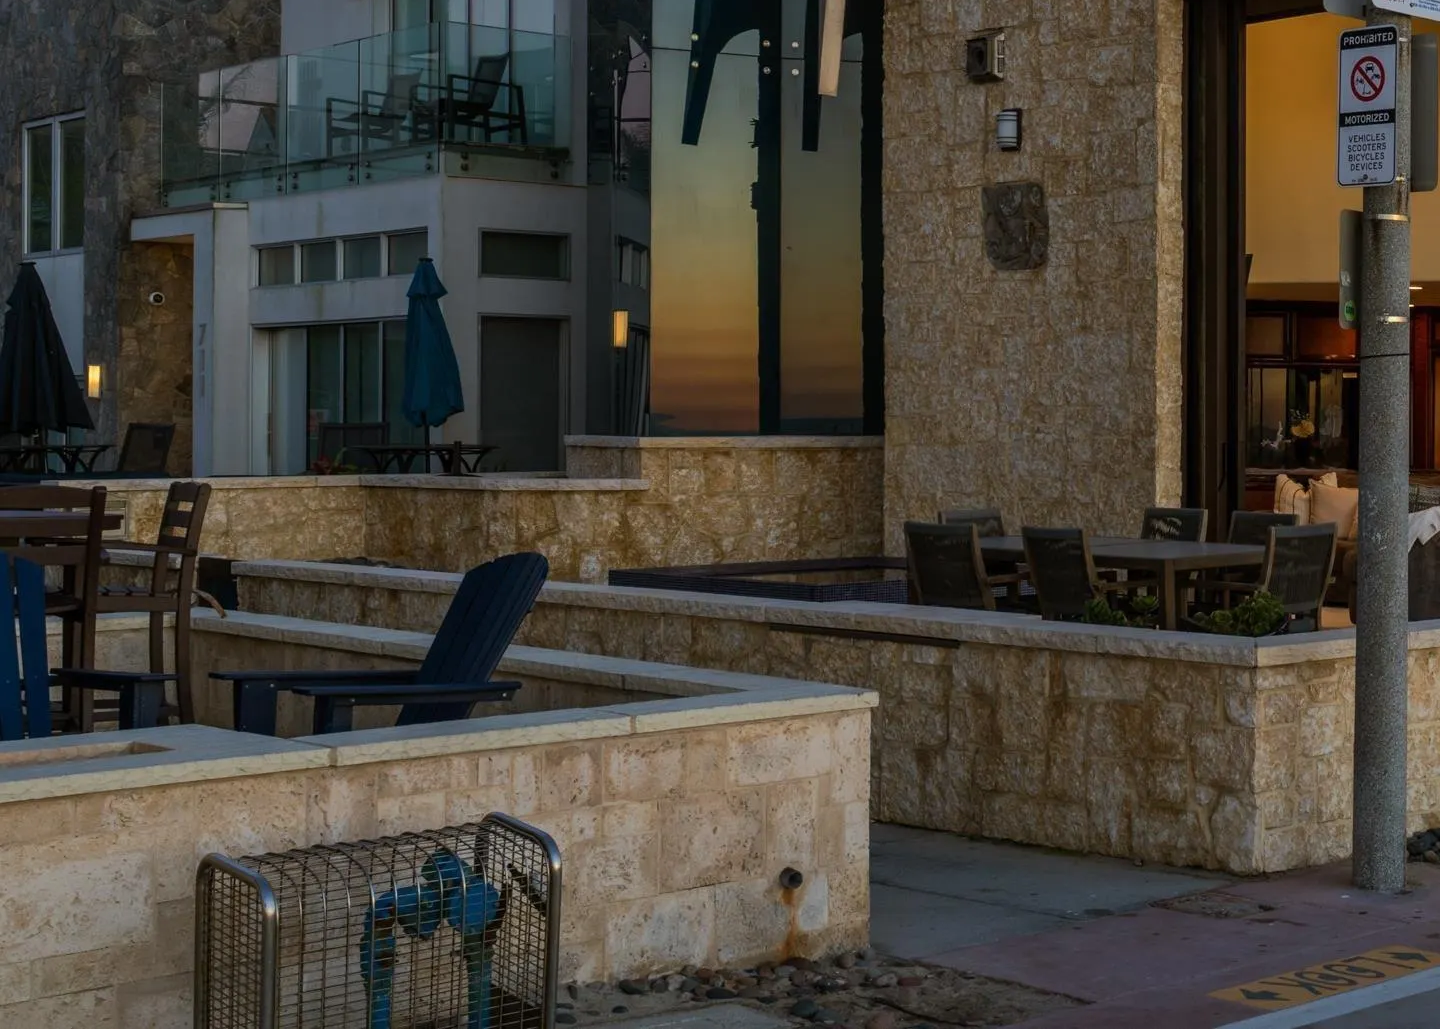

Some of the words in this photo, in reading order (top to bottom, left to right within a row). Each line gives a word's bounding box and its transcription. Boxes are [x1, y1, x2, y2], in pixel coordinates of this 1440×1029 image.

[1343, 32, 1394, 46] PROHIBITED
[1344, 112, 1390, 125] MOTORIZED
[1348, 133, 1386, 143] VEHICLES
[1347, 142, 1387, 153] SCOOTERS
[1348, 152, 1385, 162] BICYCLES
[1350, 161, 1383, 172] DEVICES
